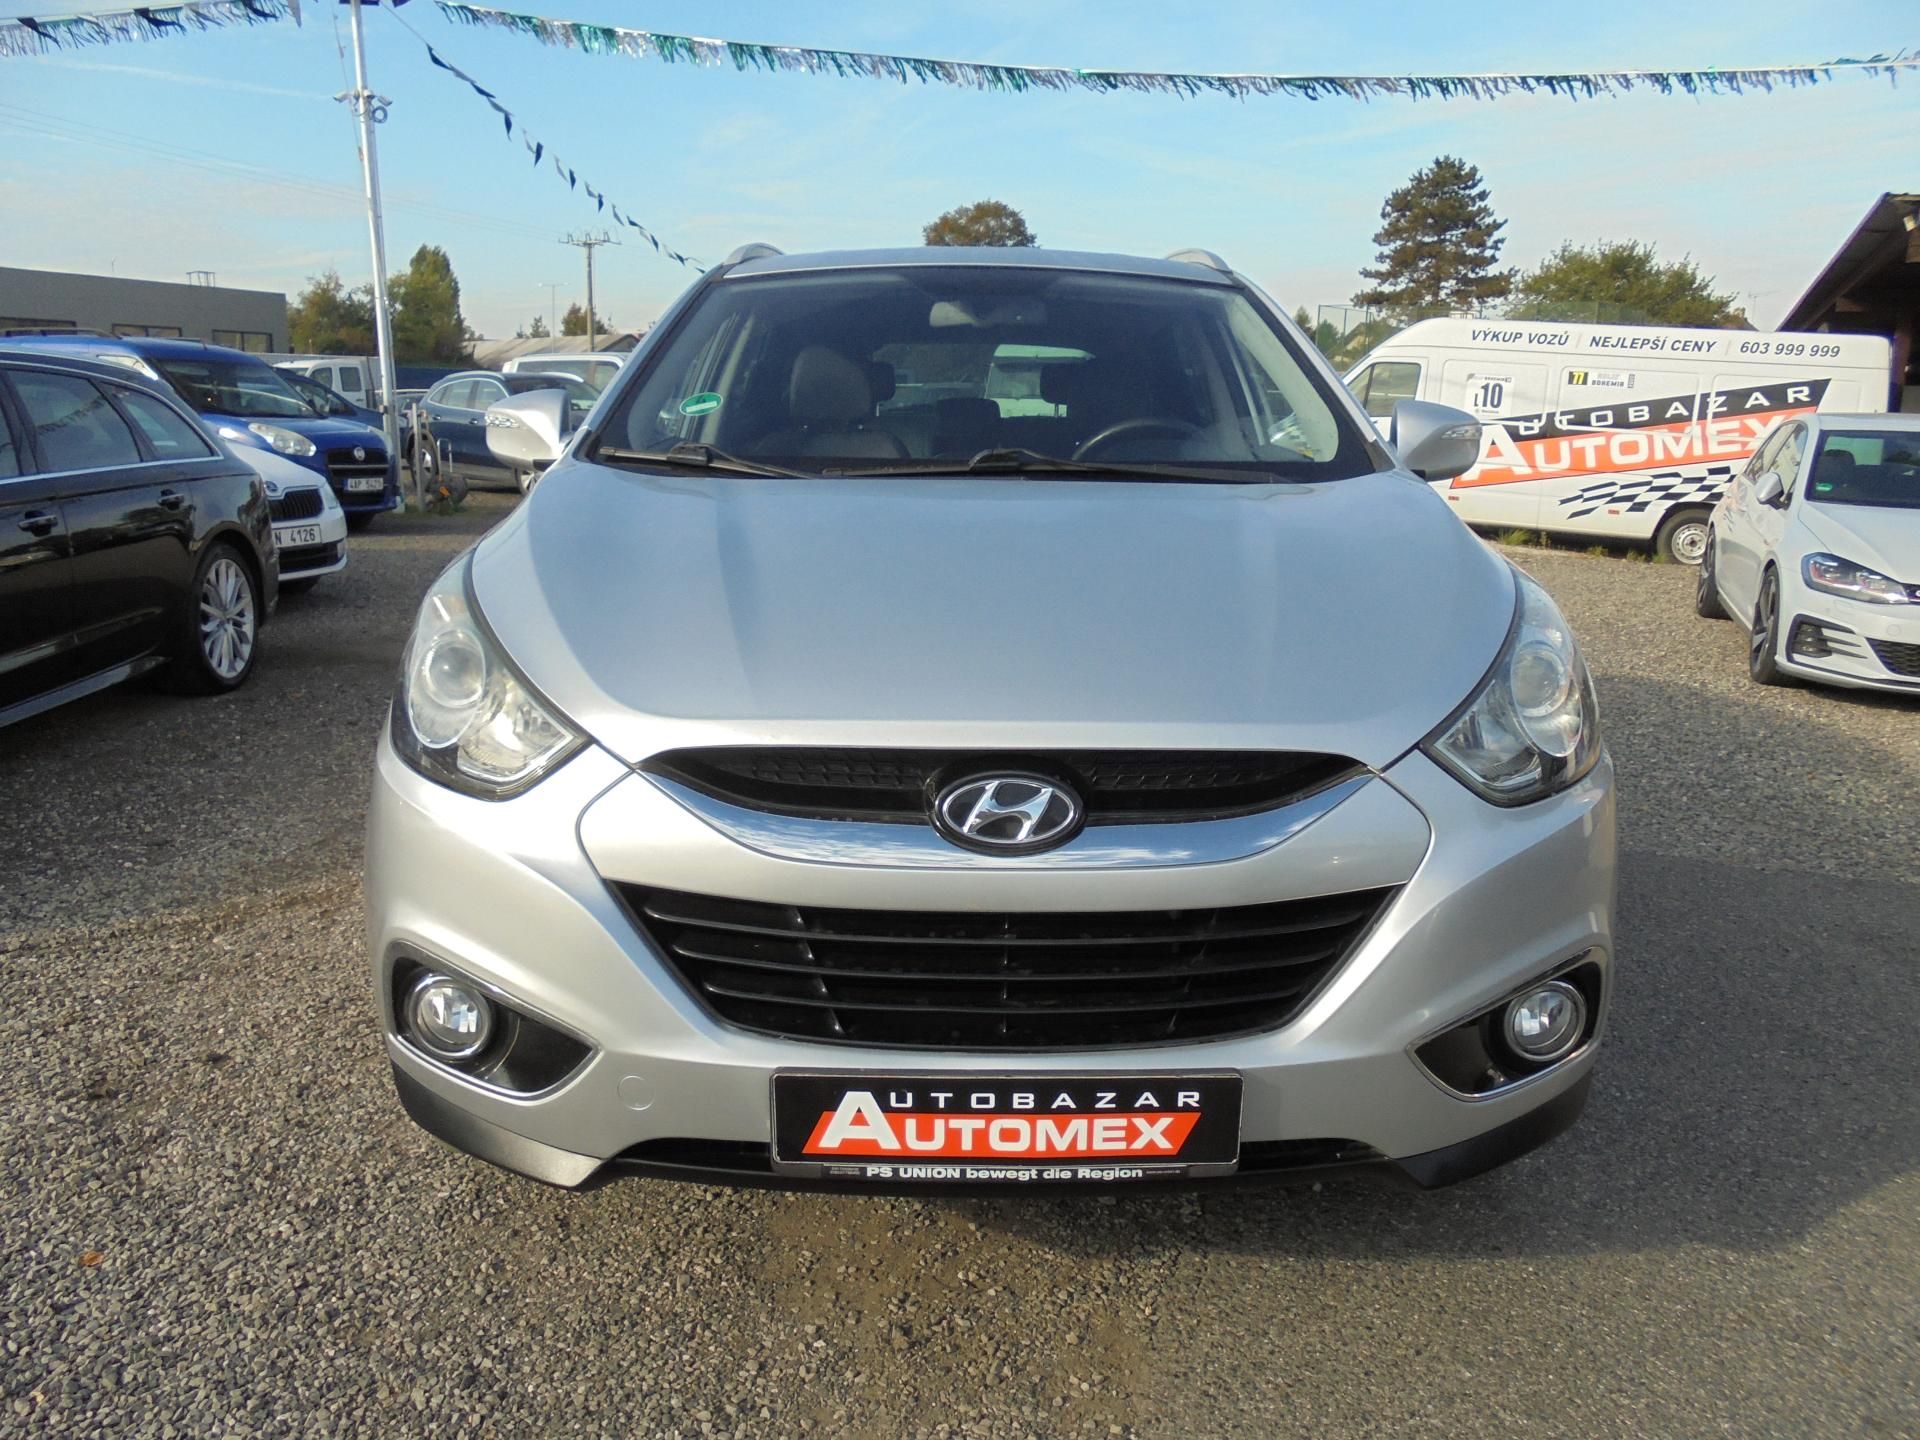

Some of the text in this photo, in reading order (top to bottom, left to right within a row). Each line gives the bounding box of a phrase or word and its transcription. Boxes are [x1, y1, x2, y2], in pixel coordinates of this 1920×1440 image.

[1472, 328, 1522, 343] VÝKUP
[1590, 335, 1668, 350] NEJLEPŠÍ
[1671, 339, 1717, 353] CENY
[1740, 341, 1770, 354] 603
[1774, 343, 1805, 356] 999
[1809, 345, 1840, 358] 999
[1480, 382, 1504, 408] 10
[290, 528, 316, 543] 4126
[818, 1091, 1175, 1152] AUTOMEX
[866, 1167, 893, 1178] PS
[900, 1167, 960, 1178] UNION
[966, 1167, 1038, 1181] bewegt
[1043, 1168, 1072, 1179] die
[1077, 1168, 1143, 1181] Region
